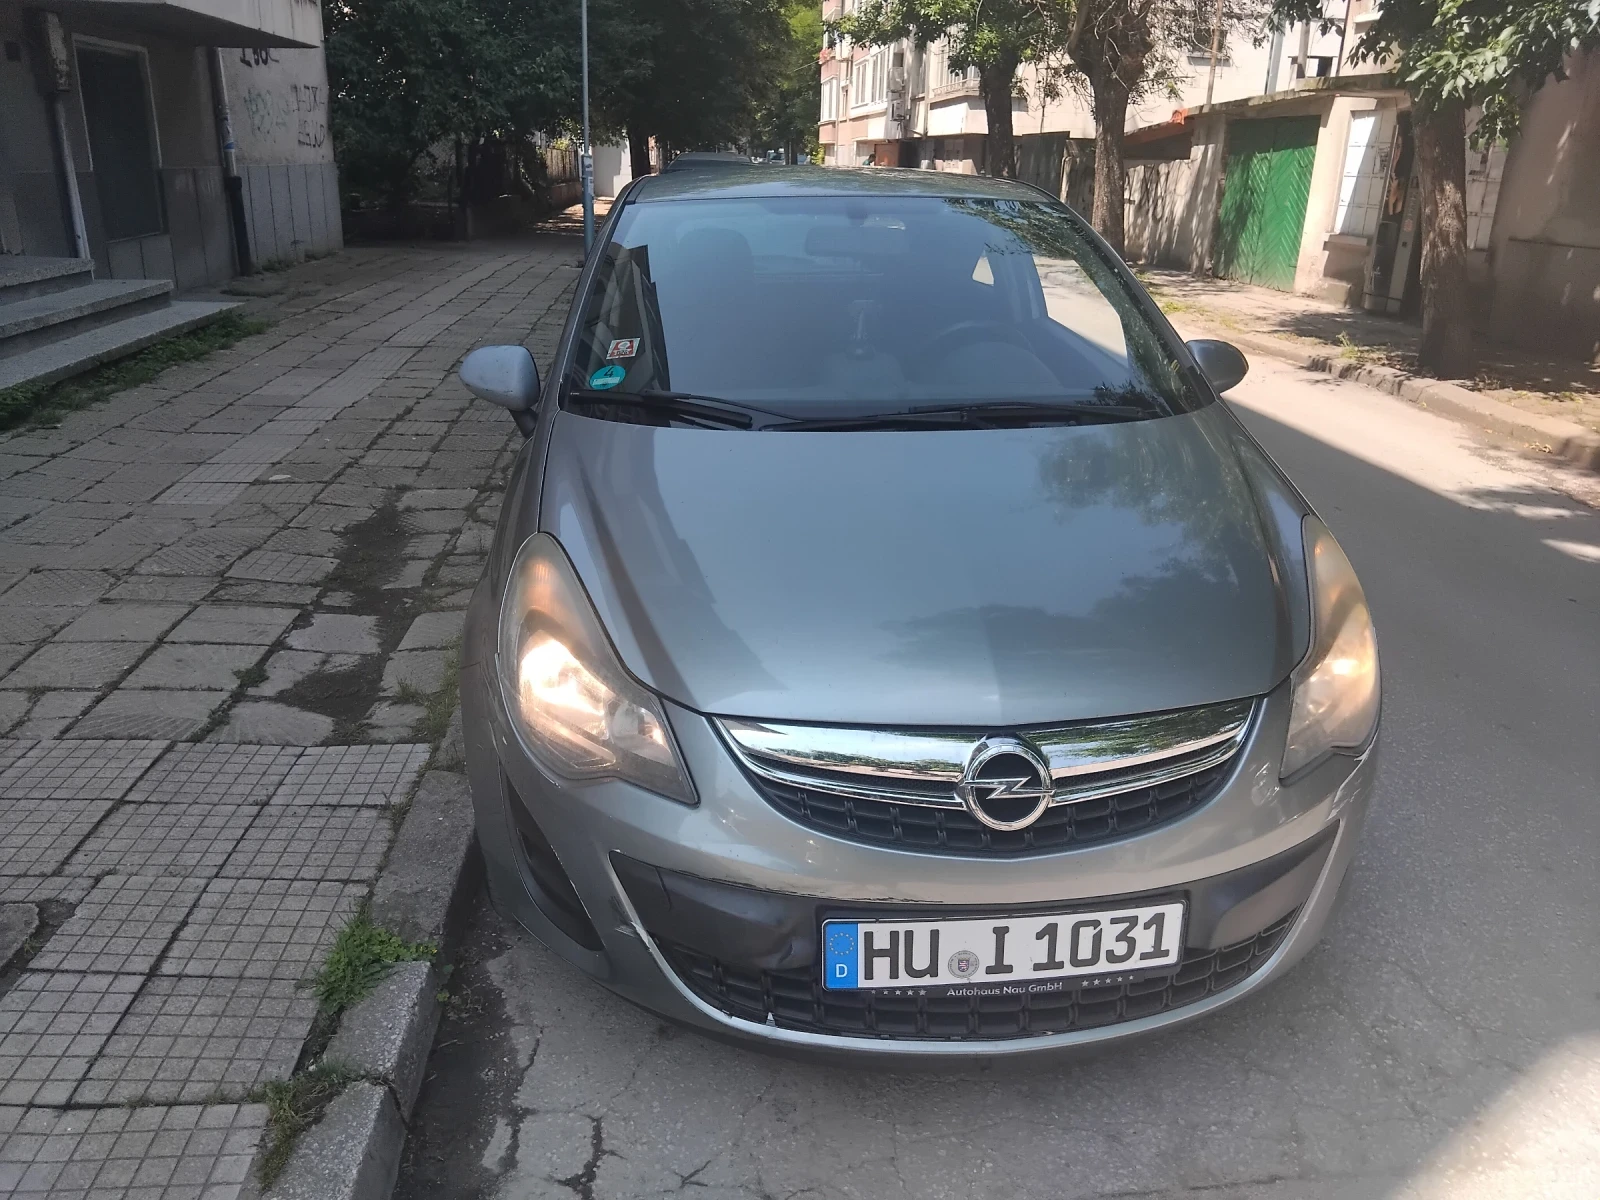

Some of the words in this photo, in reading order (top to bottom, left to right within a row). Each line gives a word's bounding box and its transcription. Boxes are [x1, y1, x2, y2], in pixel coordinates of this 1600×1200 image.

[604, 366, 614, 377] 4
[864, 929, 940, 980] HU
[985, 926, 1014, 975] I
[1033, 912, 1170, 971] 1031
[835, 963, 848, 978] D
[947, 987, 1000, 996] Autohaus
[1002, 985, 1026, 995] Nau
[1028, 981, 1063, 993] GmbH
